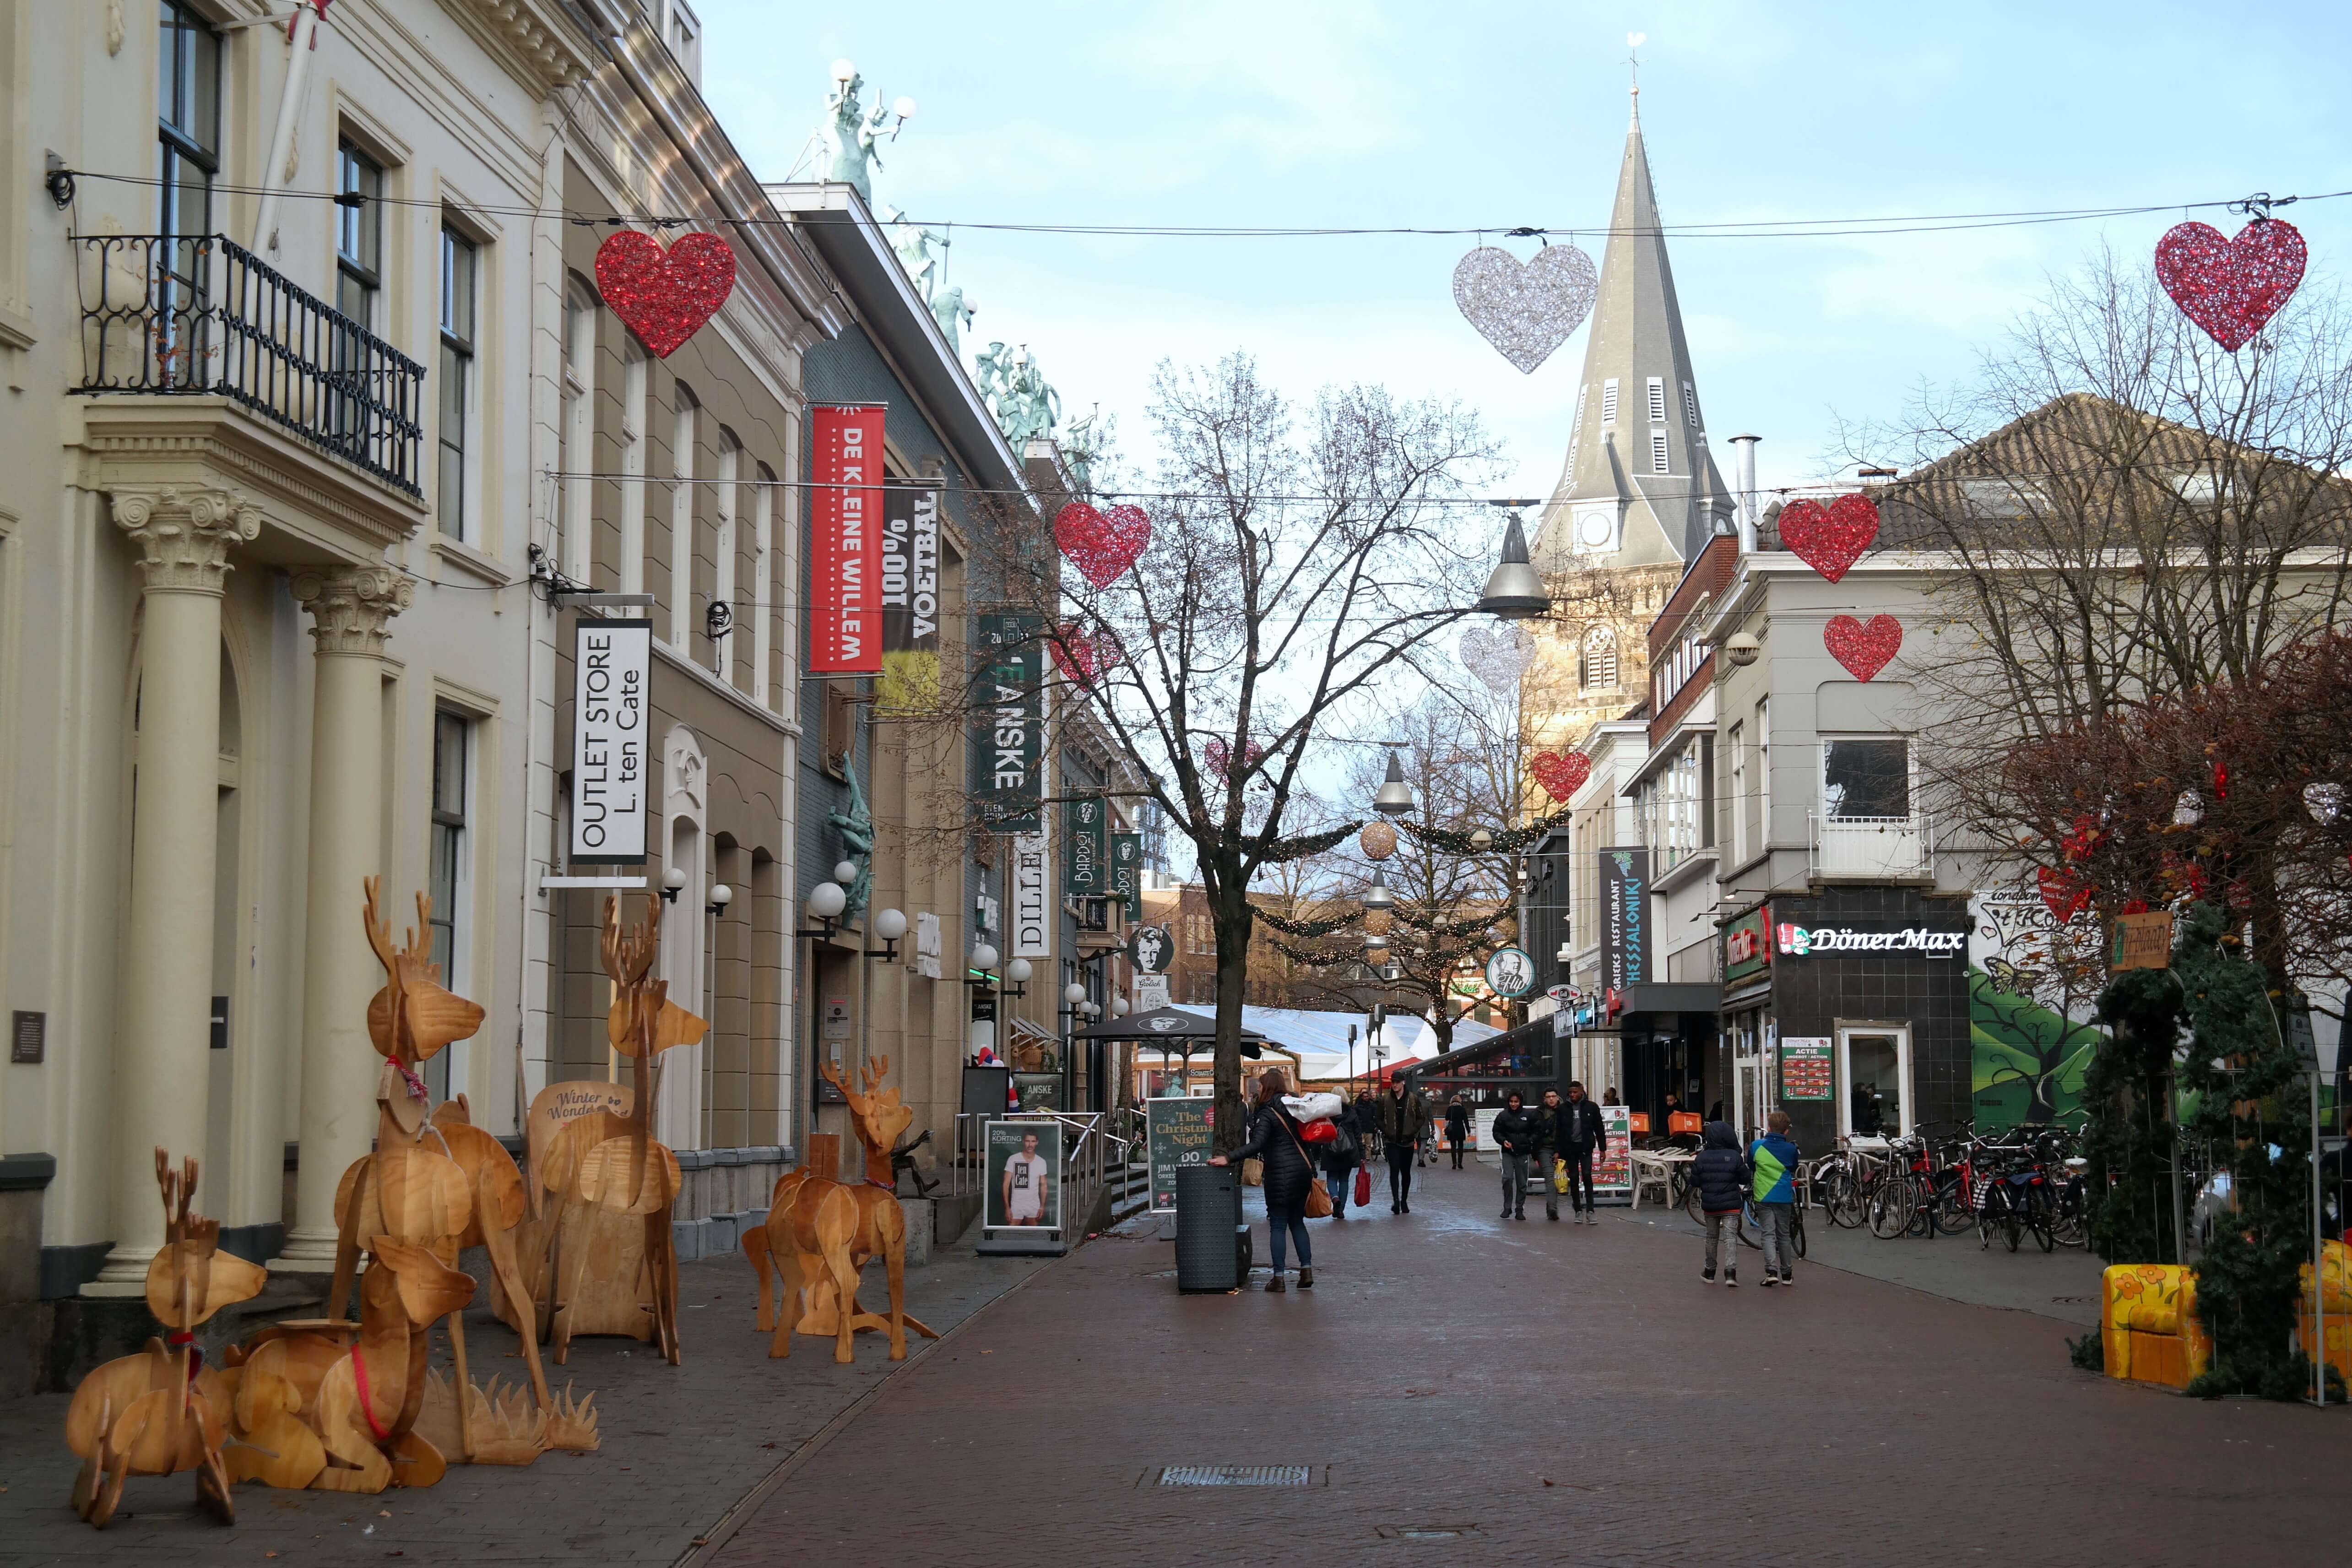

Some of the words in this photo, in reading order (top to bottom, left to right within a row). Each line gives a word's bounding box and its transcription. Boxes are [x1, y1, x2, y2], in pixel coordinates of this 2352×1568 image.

[844, 428, 862, 458] DE
[882, 520, 908, 606] 100%
[913, 491, 938, 639] VOETBAL
[841, 559, 862, 660] WILLEM
[586, 635, 611, 723] STORE
[616, 669, 639, 731] Cate
[618, 741, 637, 783] ten
[583, 732, 608, 847] OUTLET
[614, 793, 637, 813] L.
[1021, 853, 1042, 947] DILLE
[1611, 879, 1620, 946] RESTAURANT
[1810, 928, 1965, 951] DönerMax
[1497, 973, 1525, 993] Flip
[1612, 953, 1621, 991] GRIEKS
[557, 1089, 602, 1105] Winter
[1156, 1123, 1214, 1134] Christma
[1176, 1112, 1202, 1122] The
[1172, 1134, 1208, 1147] Night
[1015, 1174, 1028, 1185] Cate
[1017, 1165, 1027, 1174] ten
[1158, 1164, 1171, 1173] JIM
